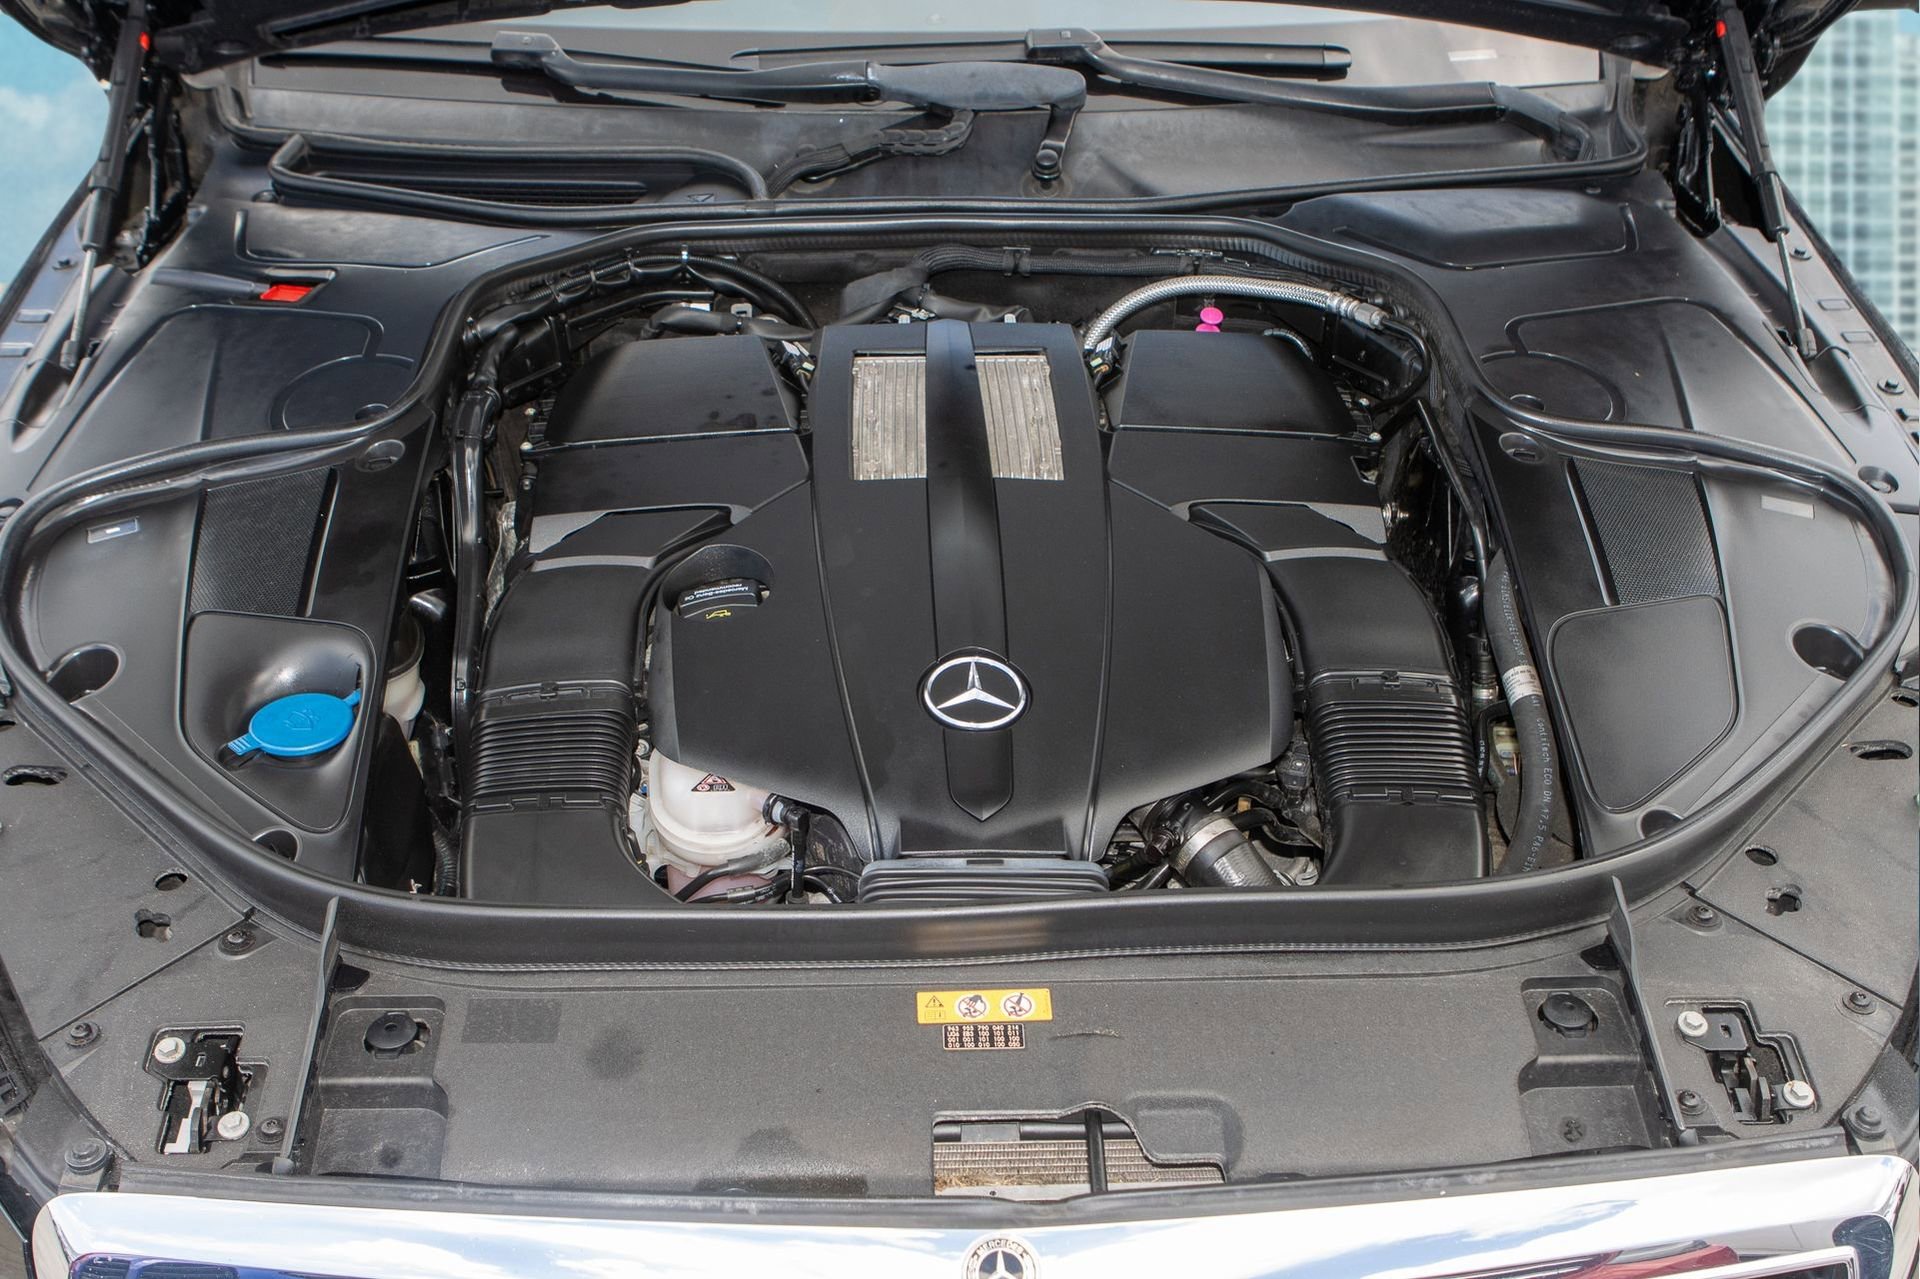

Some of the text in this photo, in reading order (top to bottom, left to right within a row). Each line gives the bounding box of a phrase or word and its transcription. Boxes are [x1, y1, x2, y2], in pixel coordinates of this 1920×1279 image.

[1543, 768, 1553, 785] ECO
[1543, 790, 1552, 803] DN
[1538, 809, 1549, 831] 17.5
